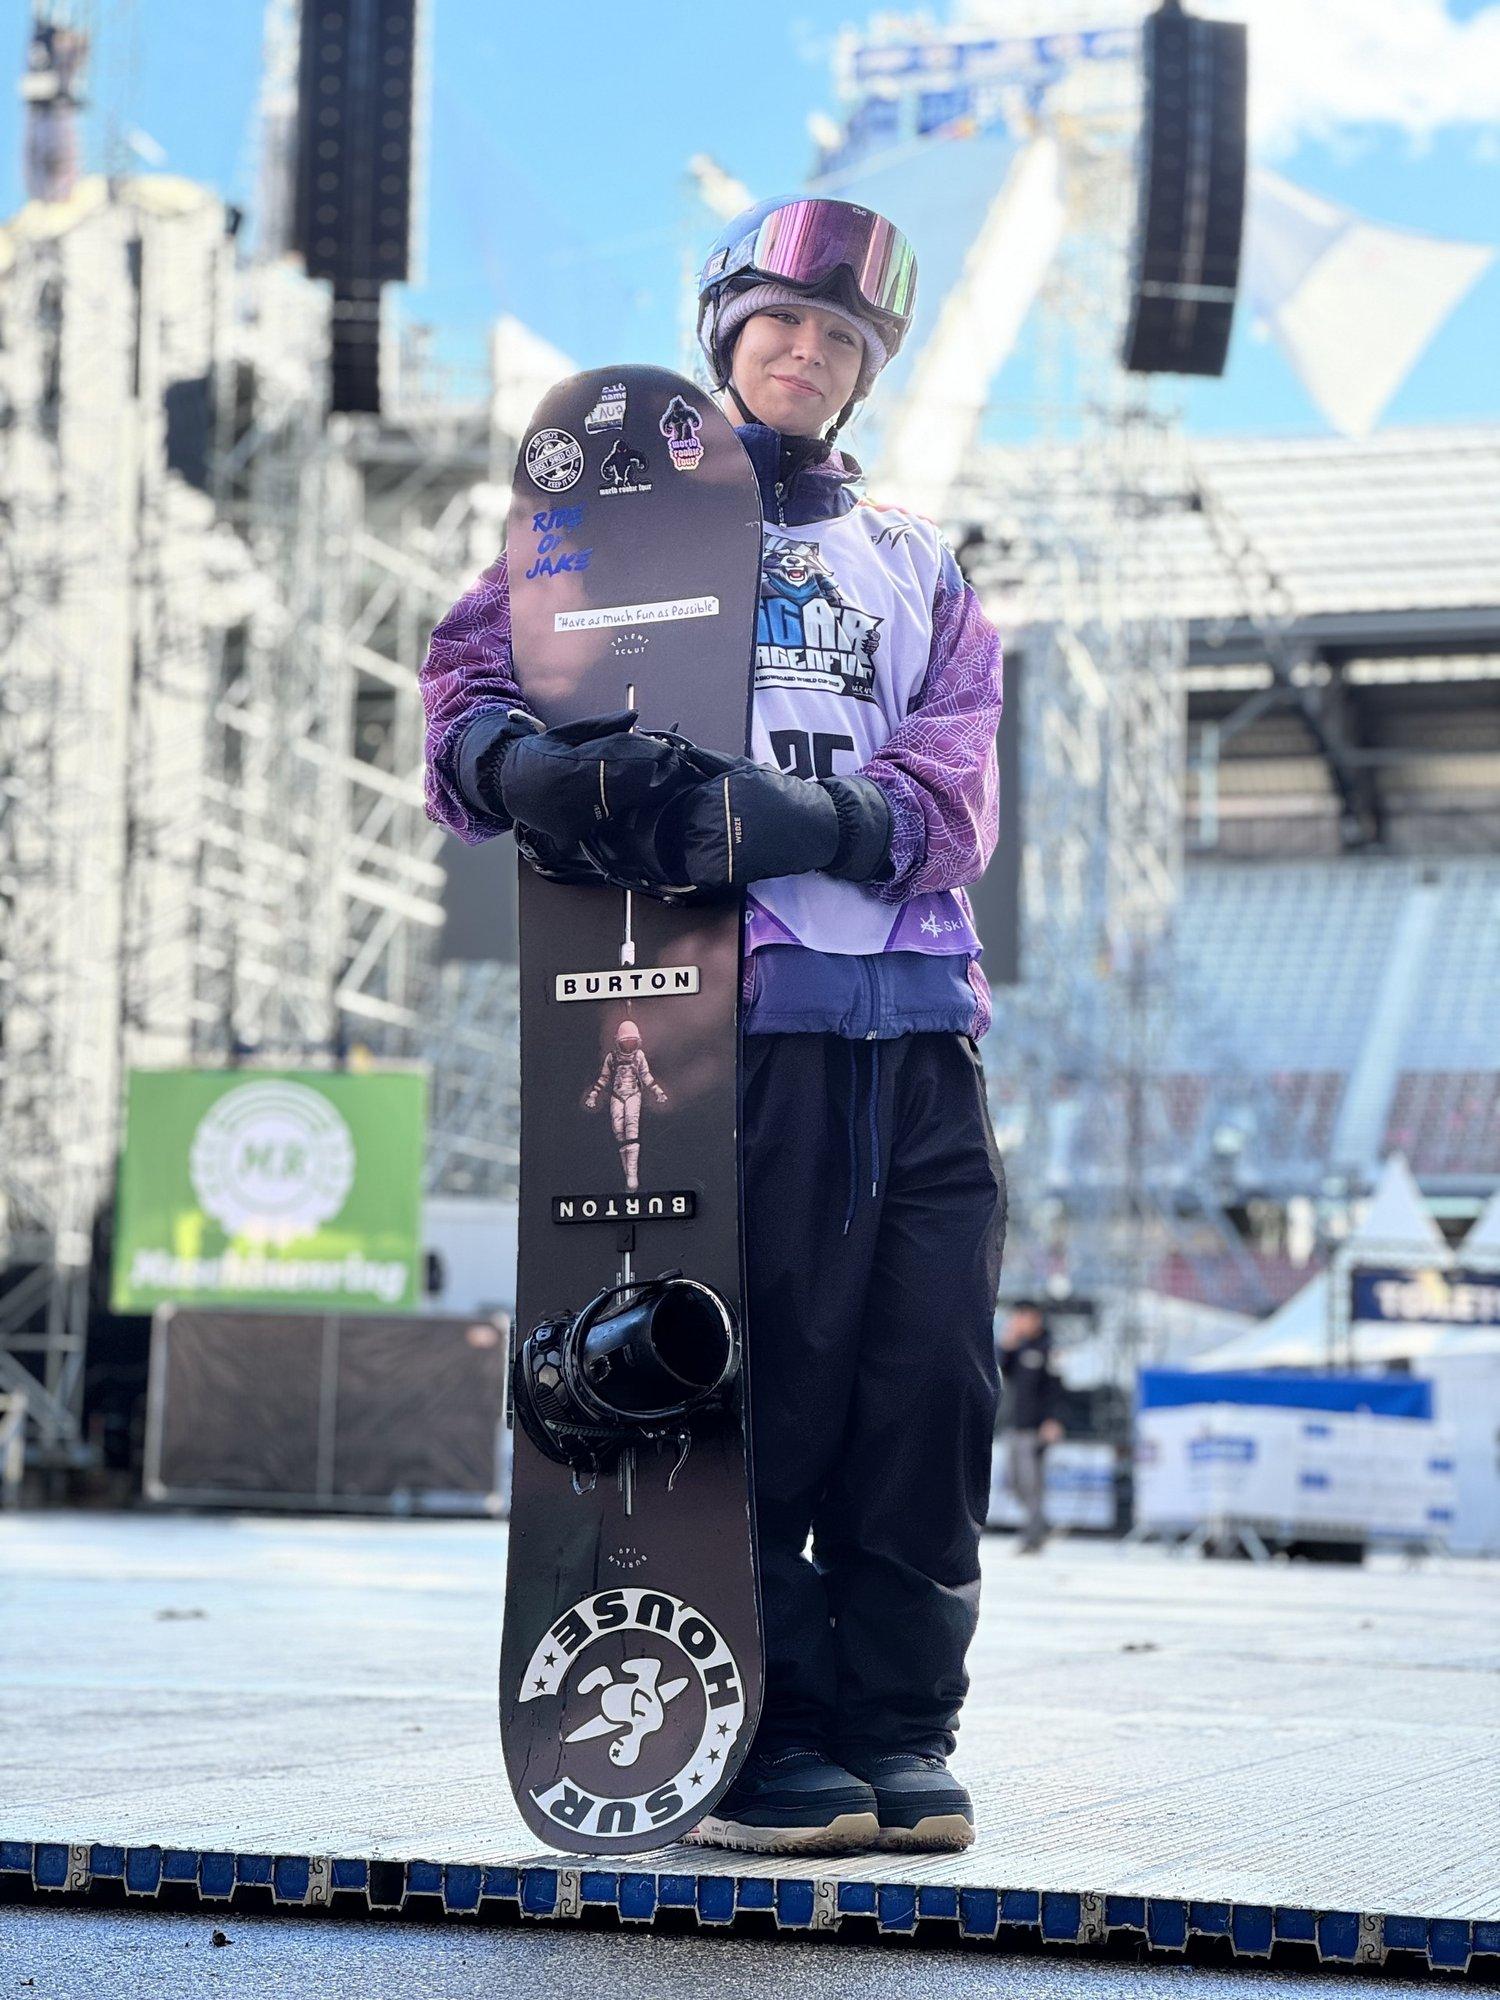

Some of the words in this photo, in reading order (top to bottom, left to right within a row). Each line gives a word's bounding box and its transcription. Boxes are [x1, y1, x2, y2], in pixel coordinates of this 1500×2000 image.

[529, 460, 549, 474] SUNSET
[547, 480, 562, 488] KEEP
[526, 548, 593, 579] JAKE
[588, 617, 600, 625] as
[658, 610, 669, 618] as
[611, 633, 649, 647] TALENT
[563, 972, 690, 995] BURTON
[559, 1196, 686, 1218] BURTON
[550, 1591, 740, 1710] HOUSE
